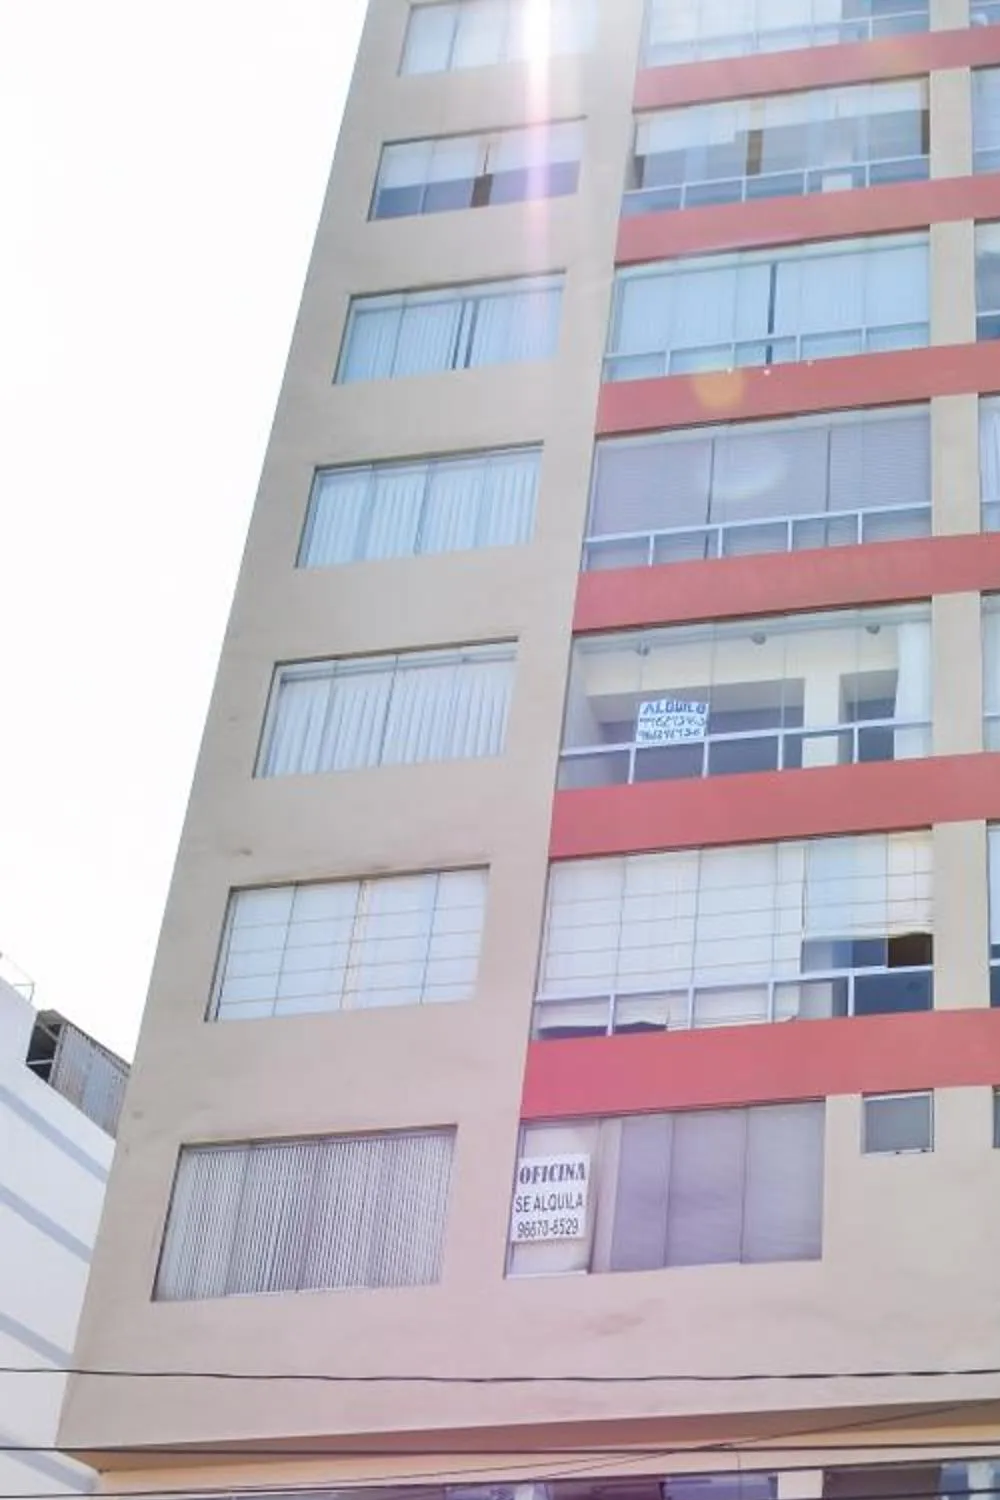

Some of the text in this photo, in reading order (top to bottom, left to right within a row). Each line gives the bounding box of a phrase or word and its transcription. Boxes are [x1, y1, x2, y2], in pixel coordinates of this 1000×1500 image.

[519, 1161, 585, 1185] OFICINA
[515, 1191, 583, 1213] SE ALQUILA
